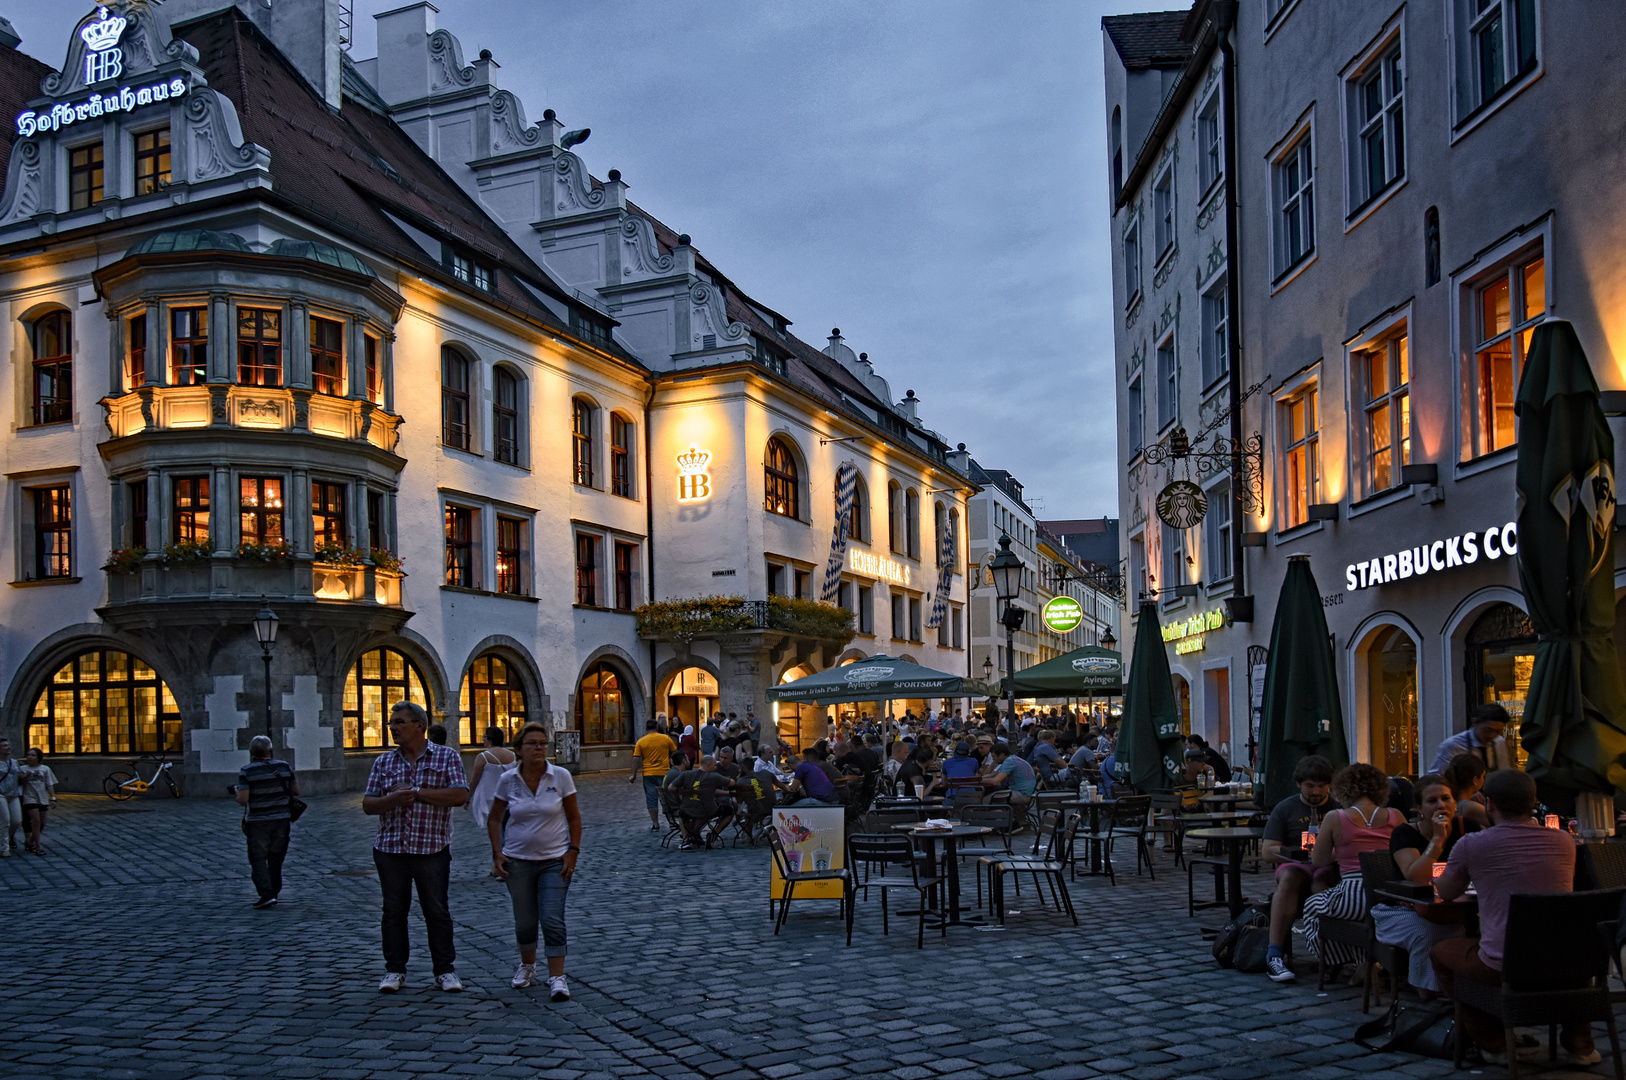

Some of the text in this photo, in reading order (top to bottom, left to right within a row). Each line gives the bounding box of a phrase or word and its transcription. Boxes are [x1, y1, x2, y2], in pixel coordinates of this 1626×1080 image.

[85, 47, 122, 86] HB
[16, 78, 187, 138] Hofbräuhaus
[678, 473, 710, 500] HB
[1346, 532, 1479, 591] STARBUCKS
[847, 680, 879, 690] Ayinger
[893, 680, 943, 689] SPORTSBAR
[1083, 675, 1115, 685] Ayinger
[778, 690, 808, 698] Dubliner
[809, 687, 826, 695] Irish
[826, 685, 840, 693] Pub
